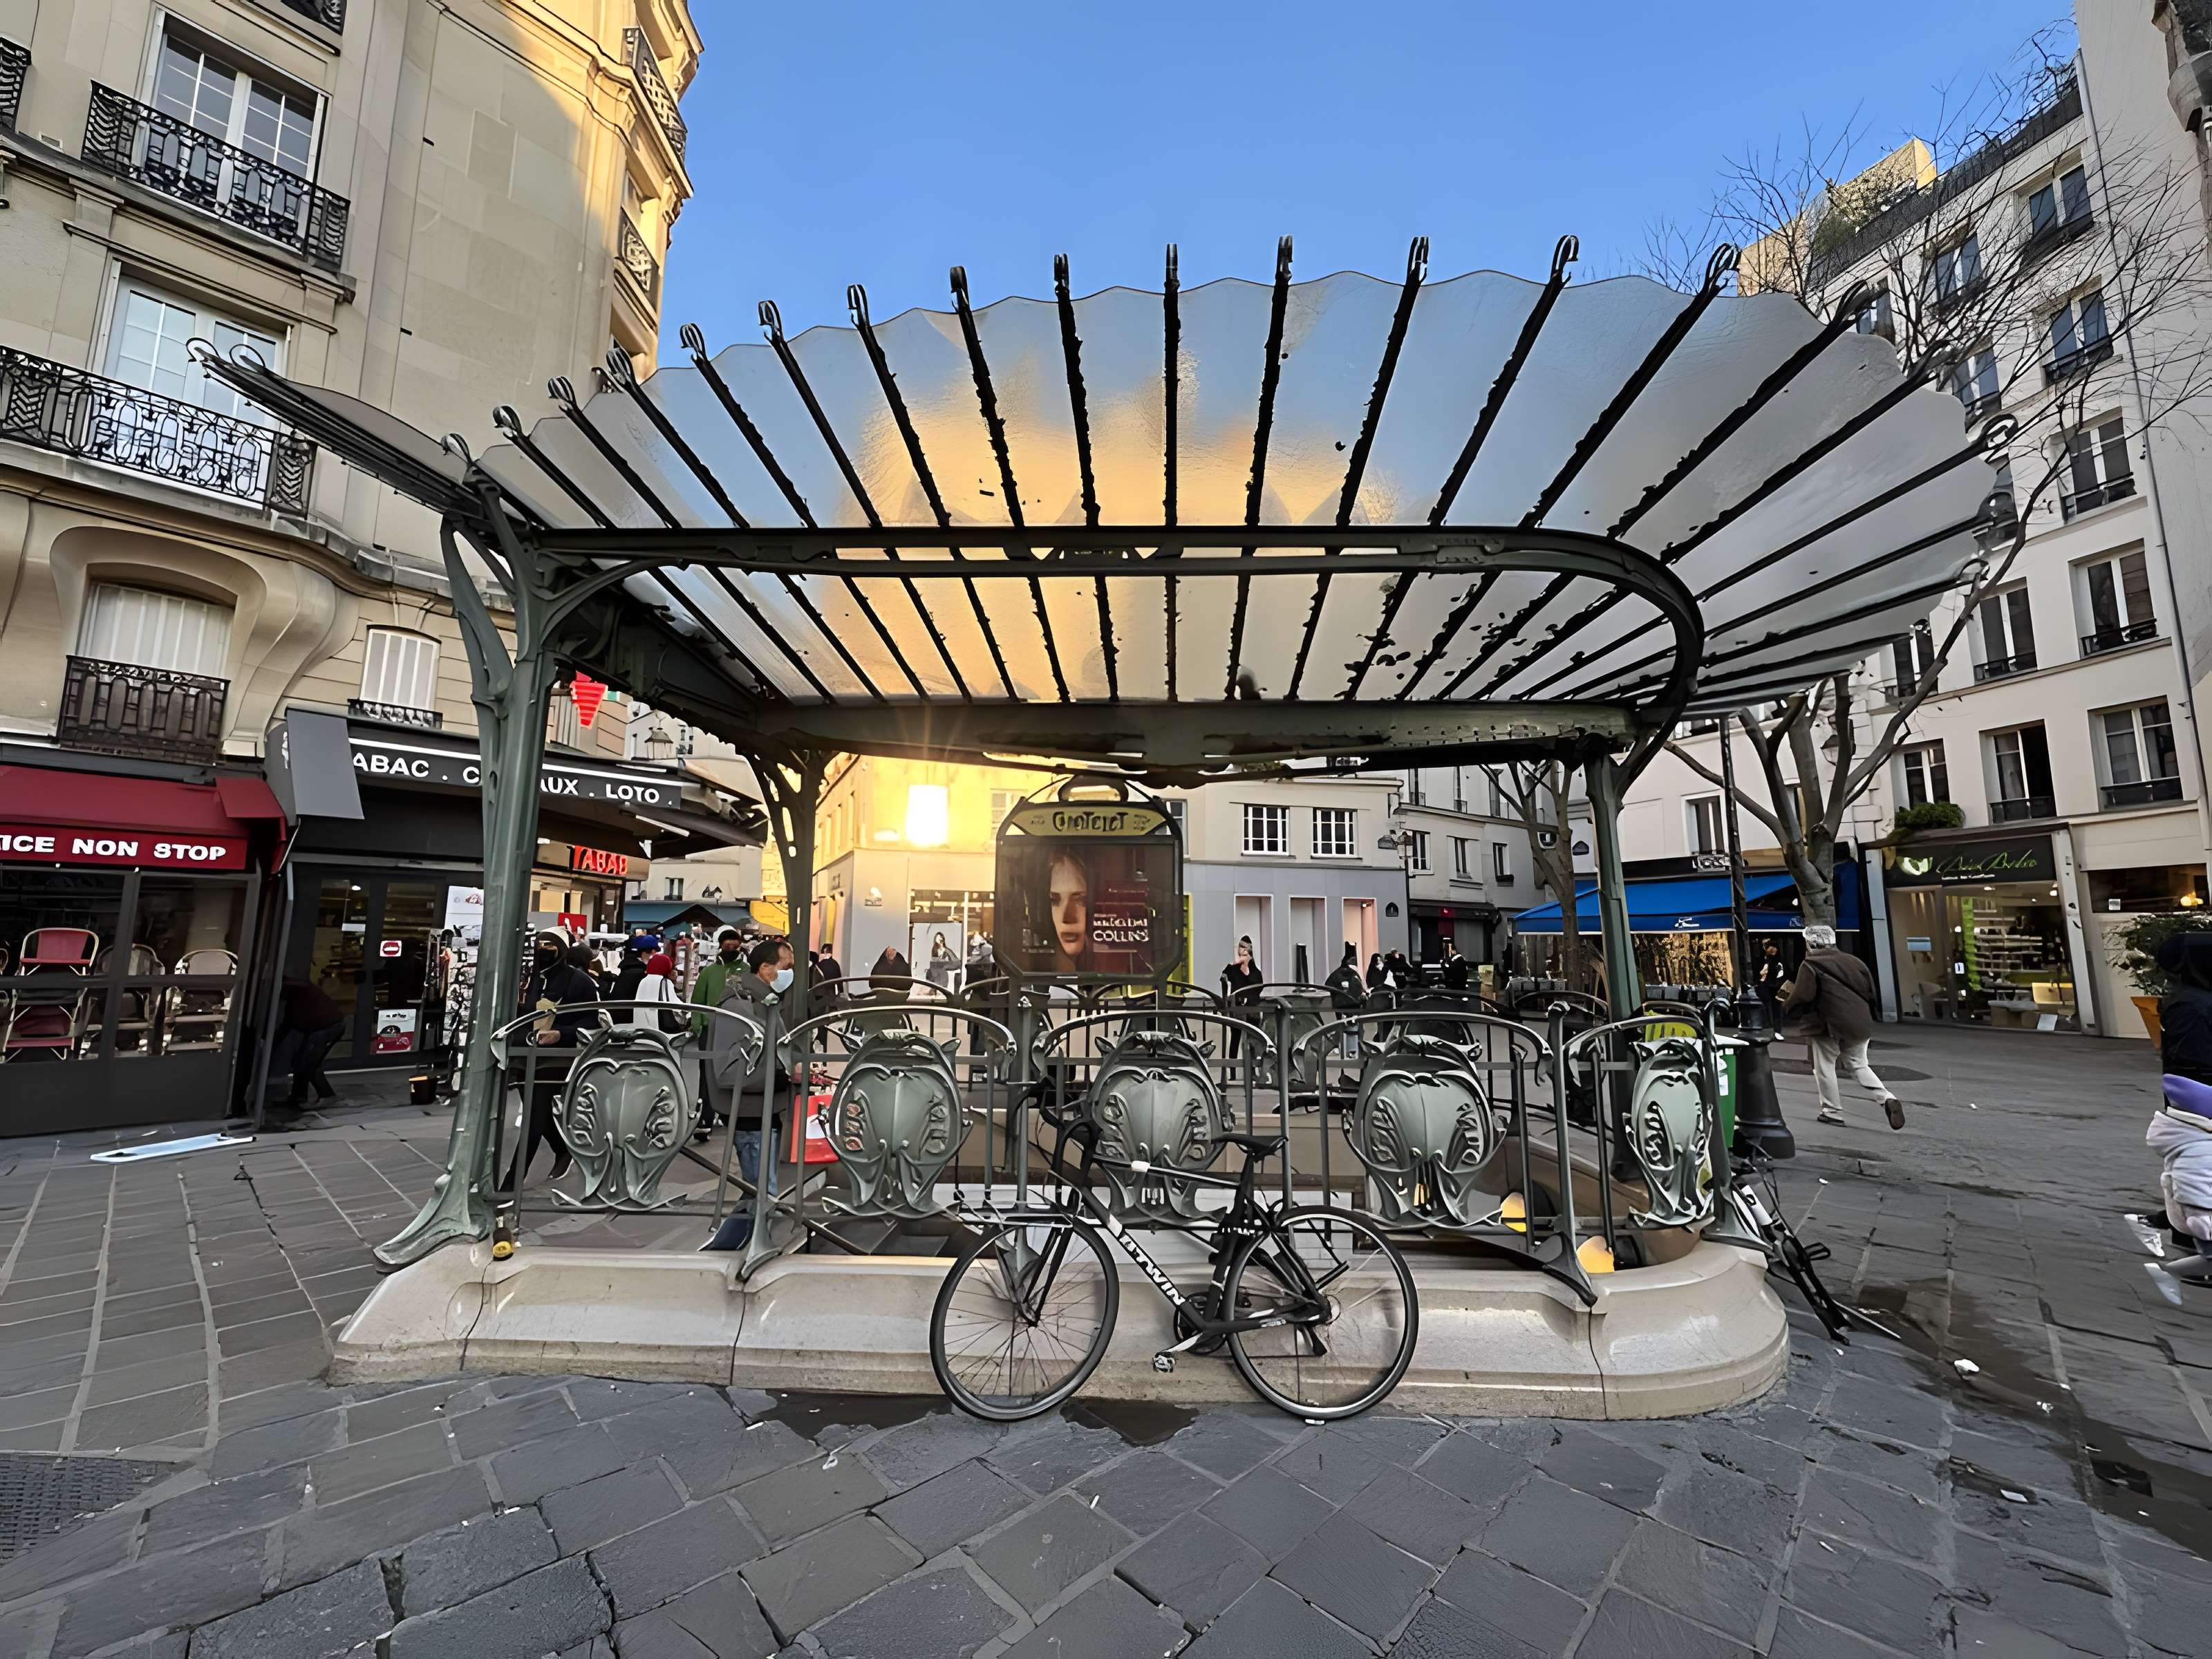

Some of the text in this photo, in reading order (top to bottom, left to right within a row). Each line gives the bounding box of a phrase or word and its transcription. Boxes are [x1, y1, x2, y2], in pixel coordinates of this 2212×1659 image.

[353, 752, 429, 778] ABAC
[606, 783, 660, 803] LOTO
[0, 834, 226, 861] ICE NON STOP
